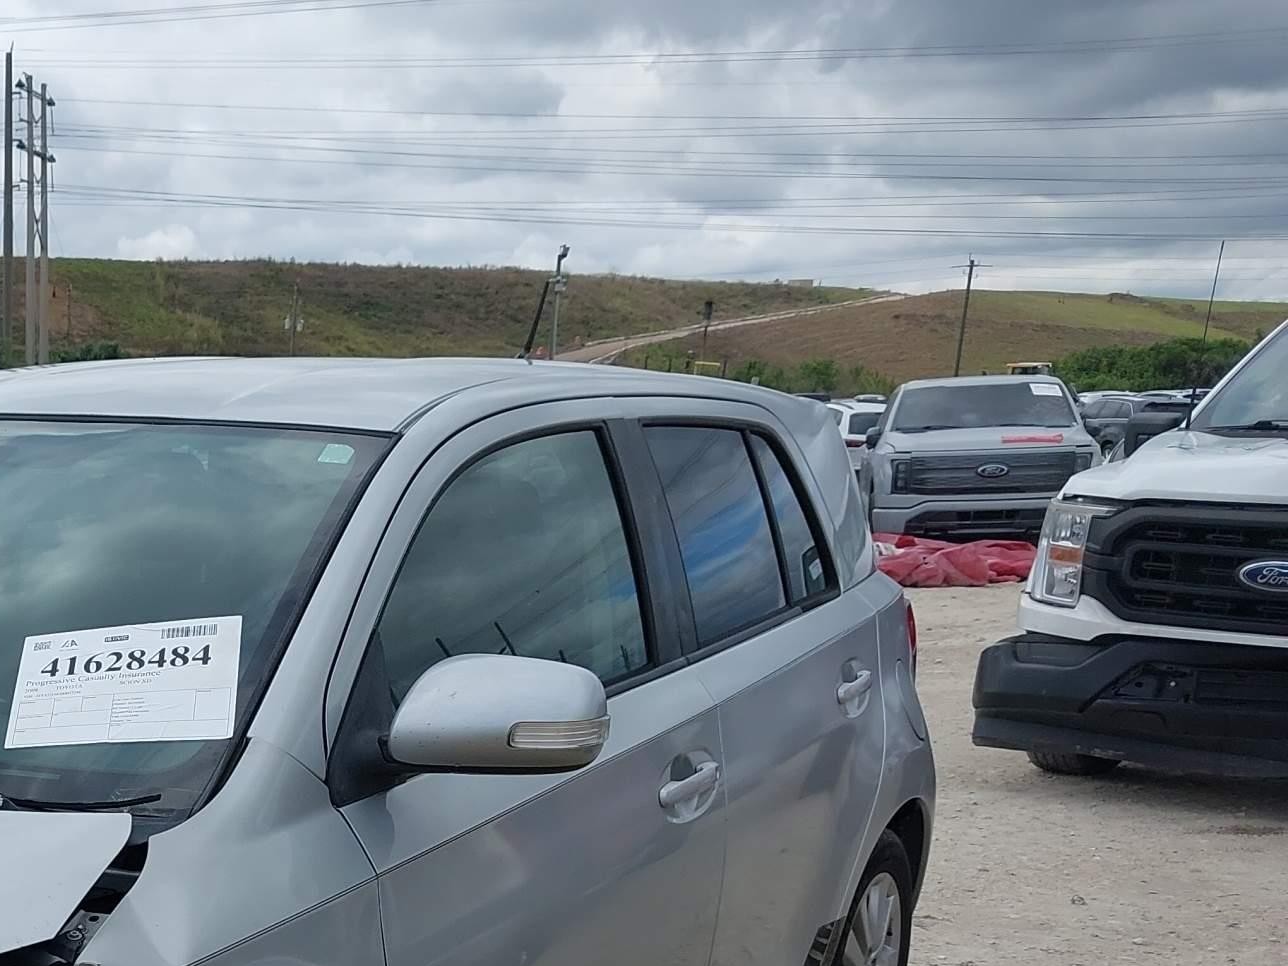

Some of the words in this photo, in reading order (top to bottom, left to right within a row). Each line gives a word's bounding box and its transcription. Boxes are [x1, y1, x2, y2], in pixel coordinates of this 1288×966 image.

[41, 643, 212, 677] 41628484
[25, 676, 76, 687] Progressive
[78, 672, 115, 682] Casualty
[118, 670, 161, 679] Insurance
